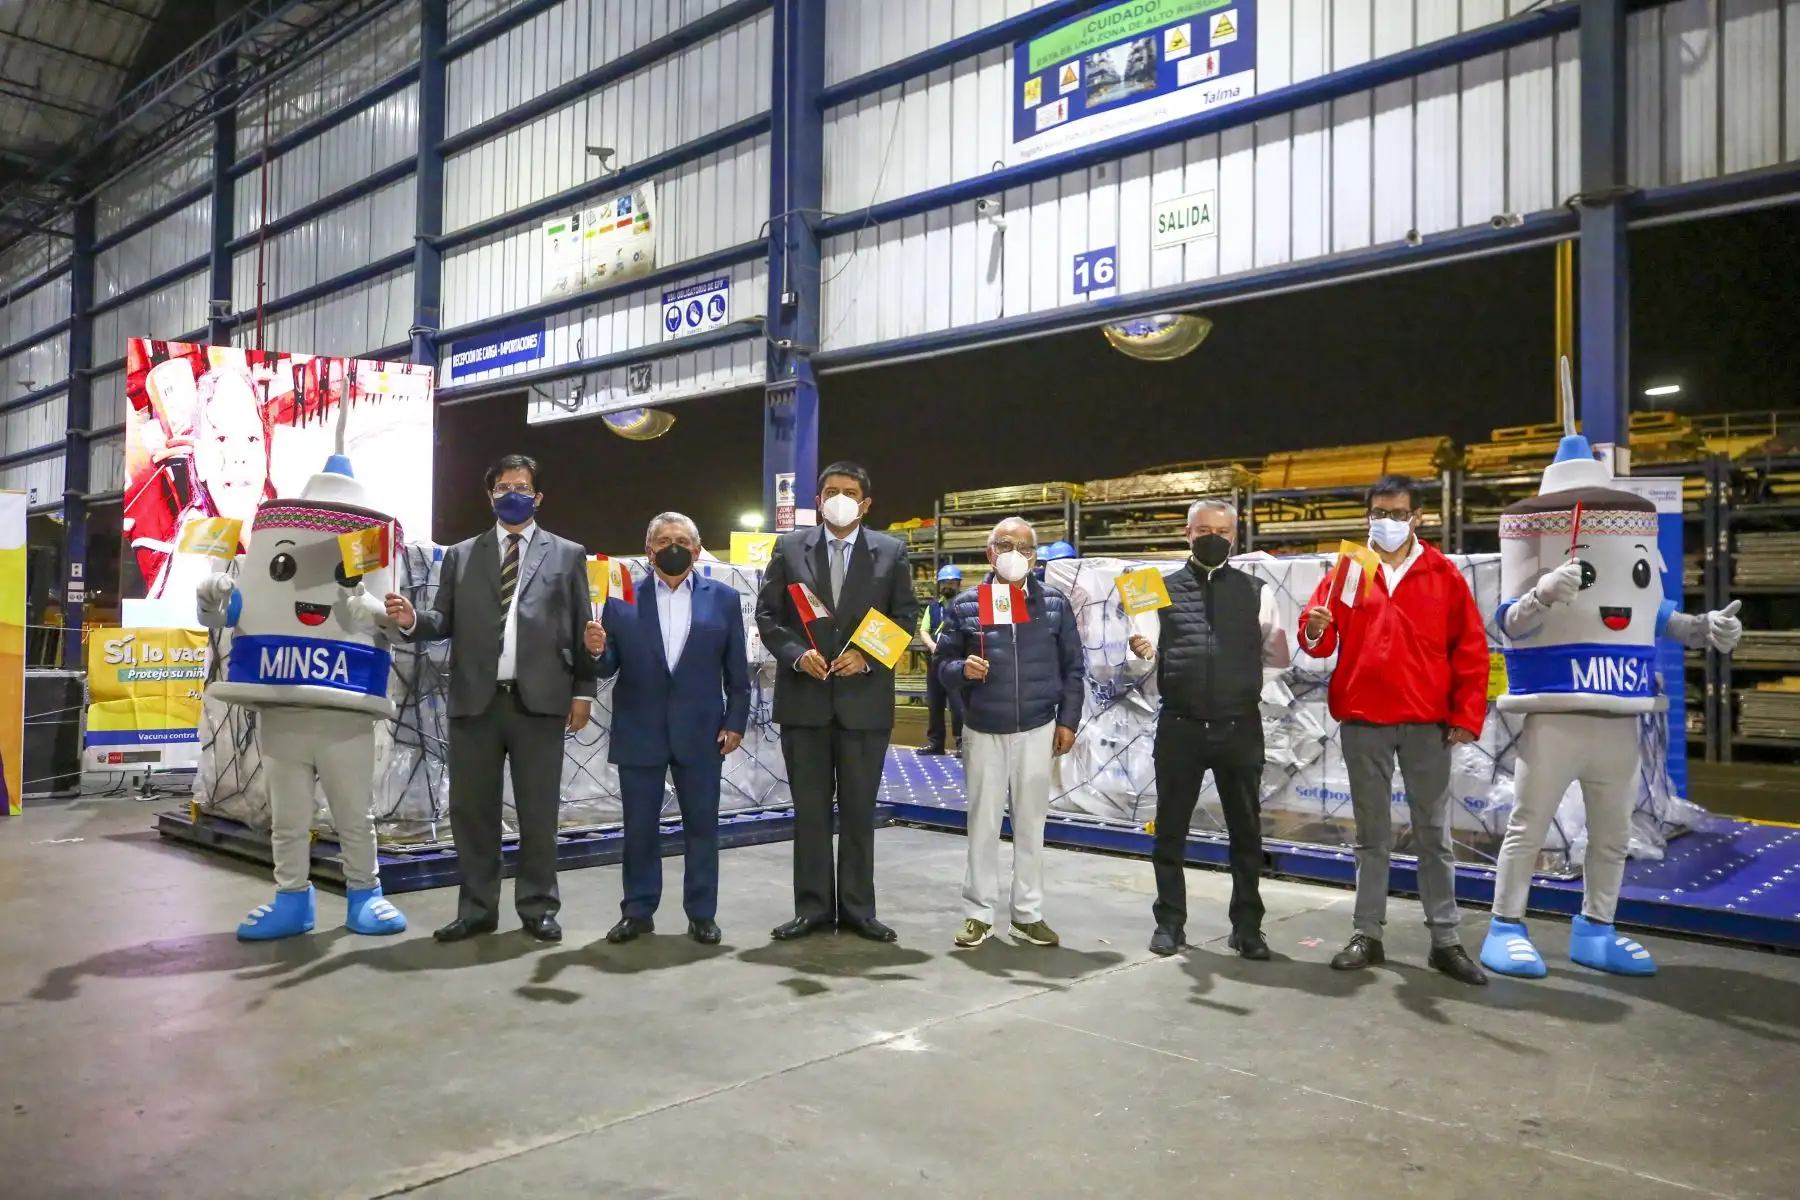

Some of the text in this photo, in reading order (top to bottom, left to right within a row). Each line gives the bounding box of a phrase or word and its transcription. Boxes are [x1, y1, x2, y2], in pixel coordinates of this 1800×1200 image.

[1074, 36, 1095, 50] UNA
[1097, 26, 1126, 41] ZONA
[1128, 19, 1144, 31] DE
[1147, 9, 1174, 24] ALTO
[1202, 86, 1241, 105] Talma
[1158, 203, 1210, 233] SALIDA
[1075, 257, 1114, 287] 16
[630, 365, 649, 389] 17
[104, 634, 138, 666] Sí,
[143, 643, 164, 662] lo
[259, 646, 349, 684] MINSA
[128, 669, 169, 681] Protejo
[170, 670, 184, 678] su
[1570, 656, 1649, 692] MINSA
[169, 731, 195, 740] contra
